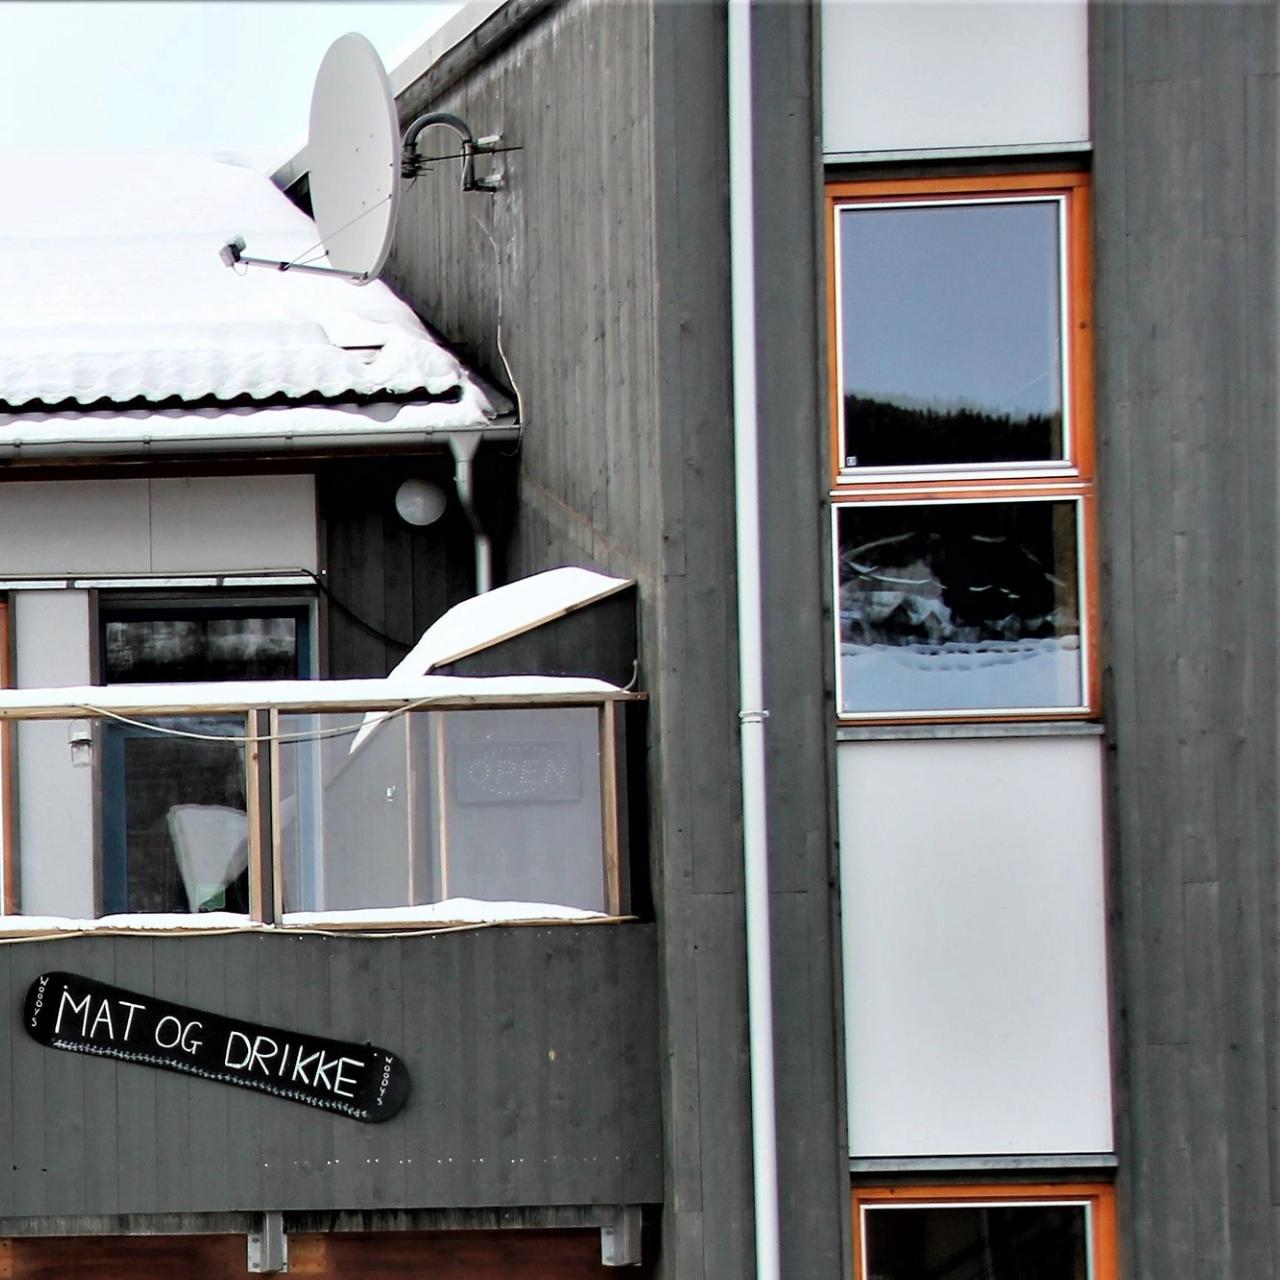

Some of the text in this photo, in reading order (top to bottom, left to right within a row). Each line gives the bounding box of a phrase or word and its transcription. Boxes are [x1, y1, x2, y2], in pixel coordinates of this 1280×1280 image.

[468, 759, 567, 784] OPEN
[54, 990, 366, 1098] MAT OG DRIKKE
